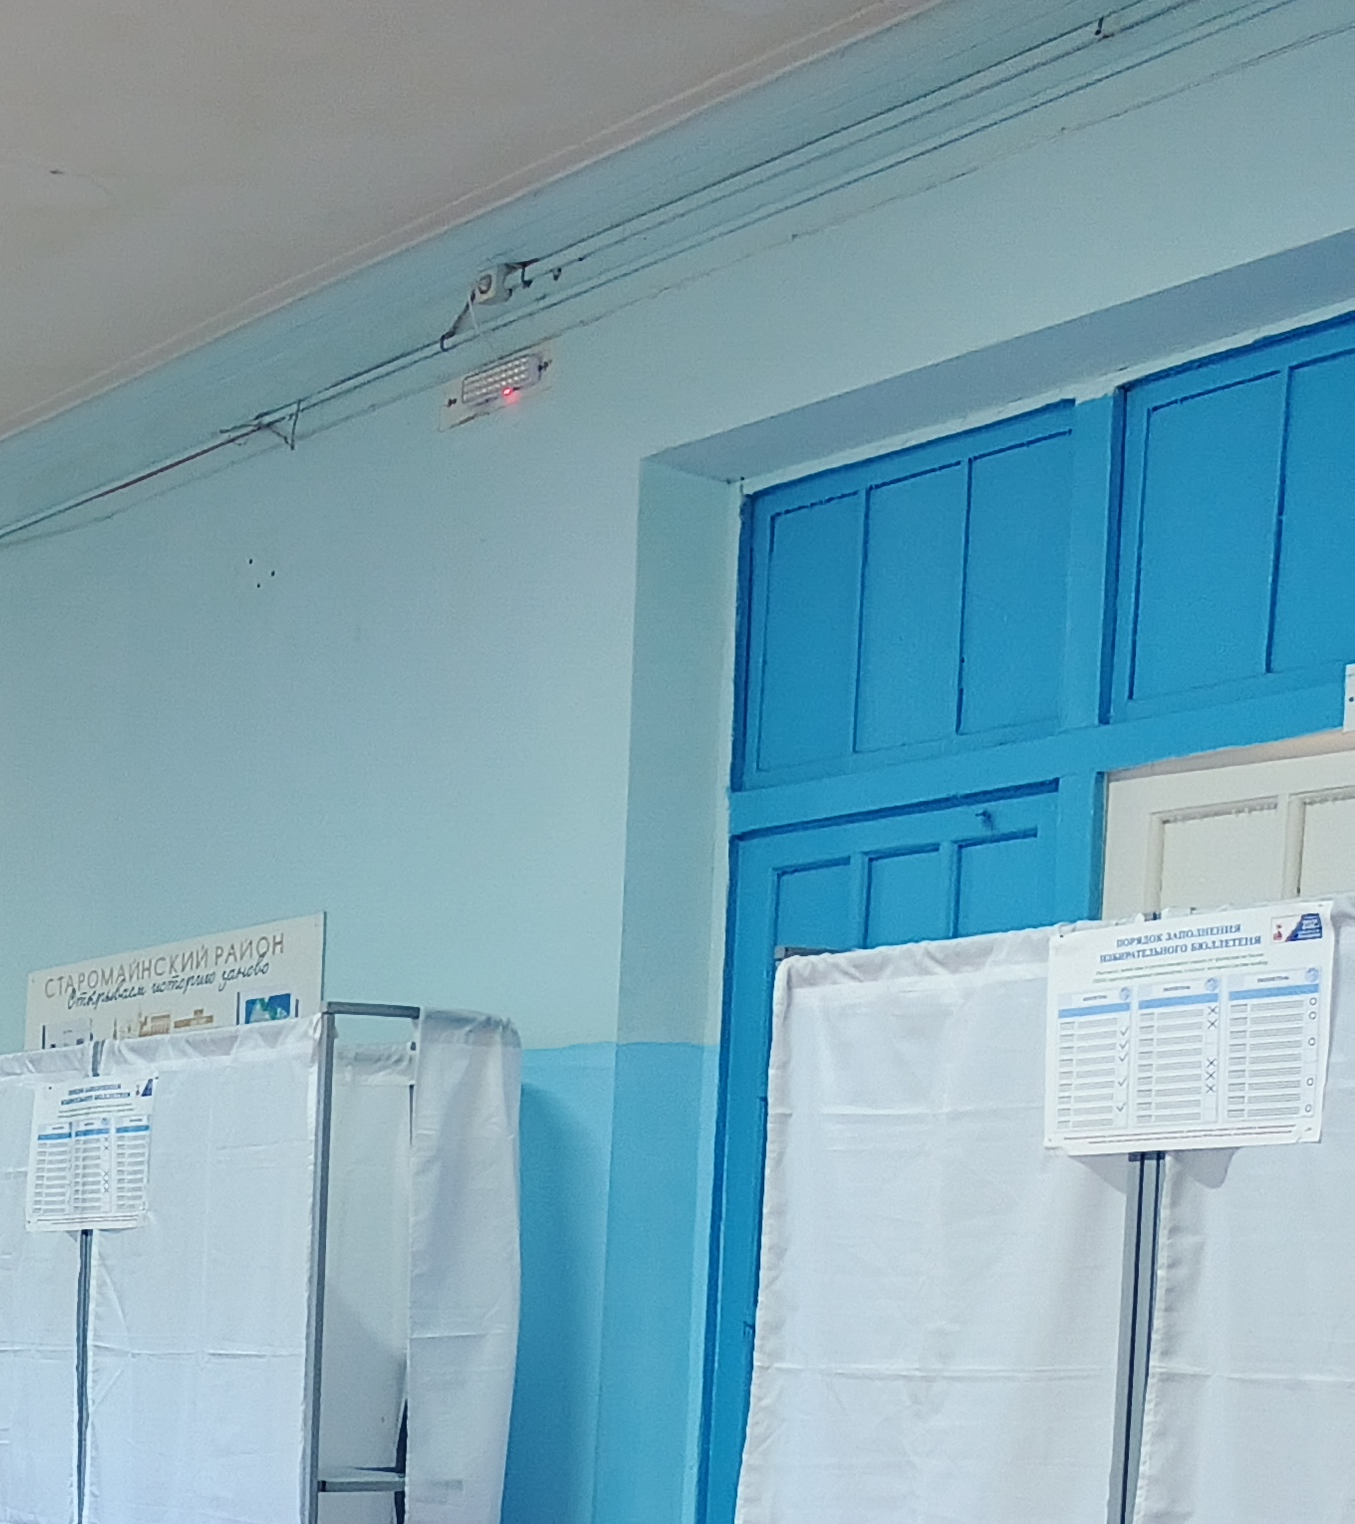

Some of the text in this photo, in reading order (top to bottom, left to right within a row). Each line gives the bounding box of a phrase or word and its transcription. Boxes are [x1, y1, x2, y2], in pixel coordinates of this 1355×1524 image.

[1099, 943, 1188, 963] ИЗБИРАТЕЛЬНОГО
[1116, 923, 1241, 949] ПОРЯДОК ЗАПОЛНЕНИЯ
[44, 932, 284, 999] СТАРОМАЙНСКИЙ РАЙОН
[67, 950, 270, 1010] Открываем историю заново
